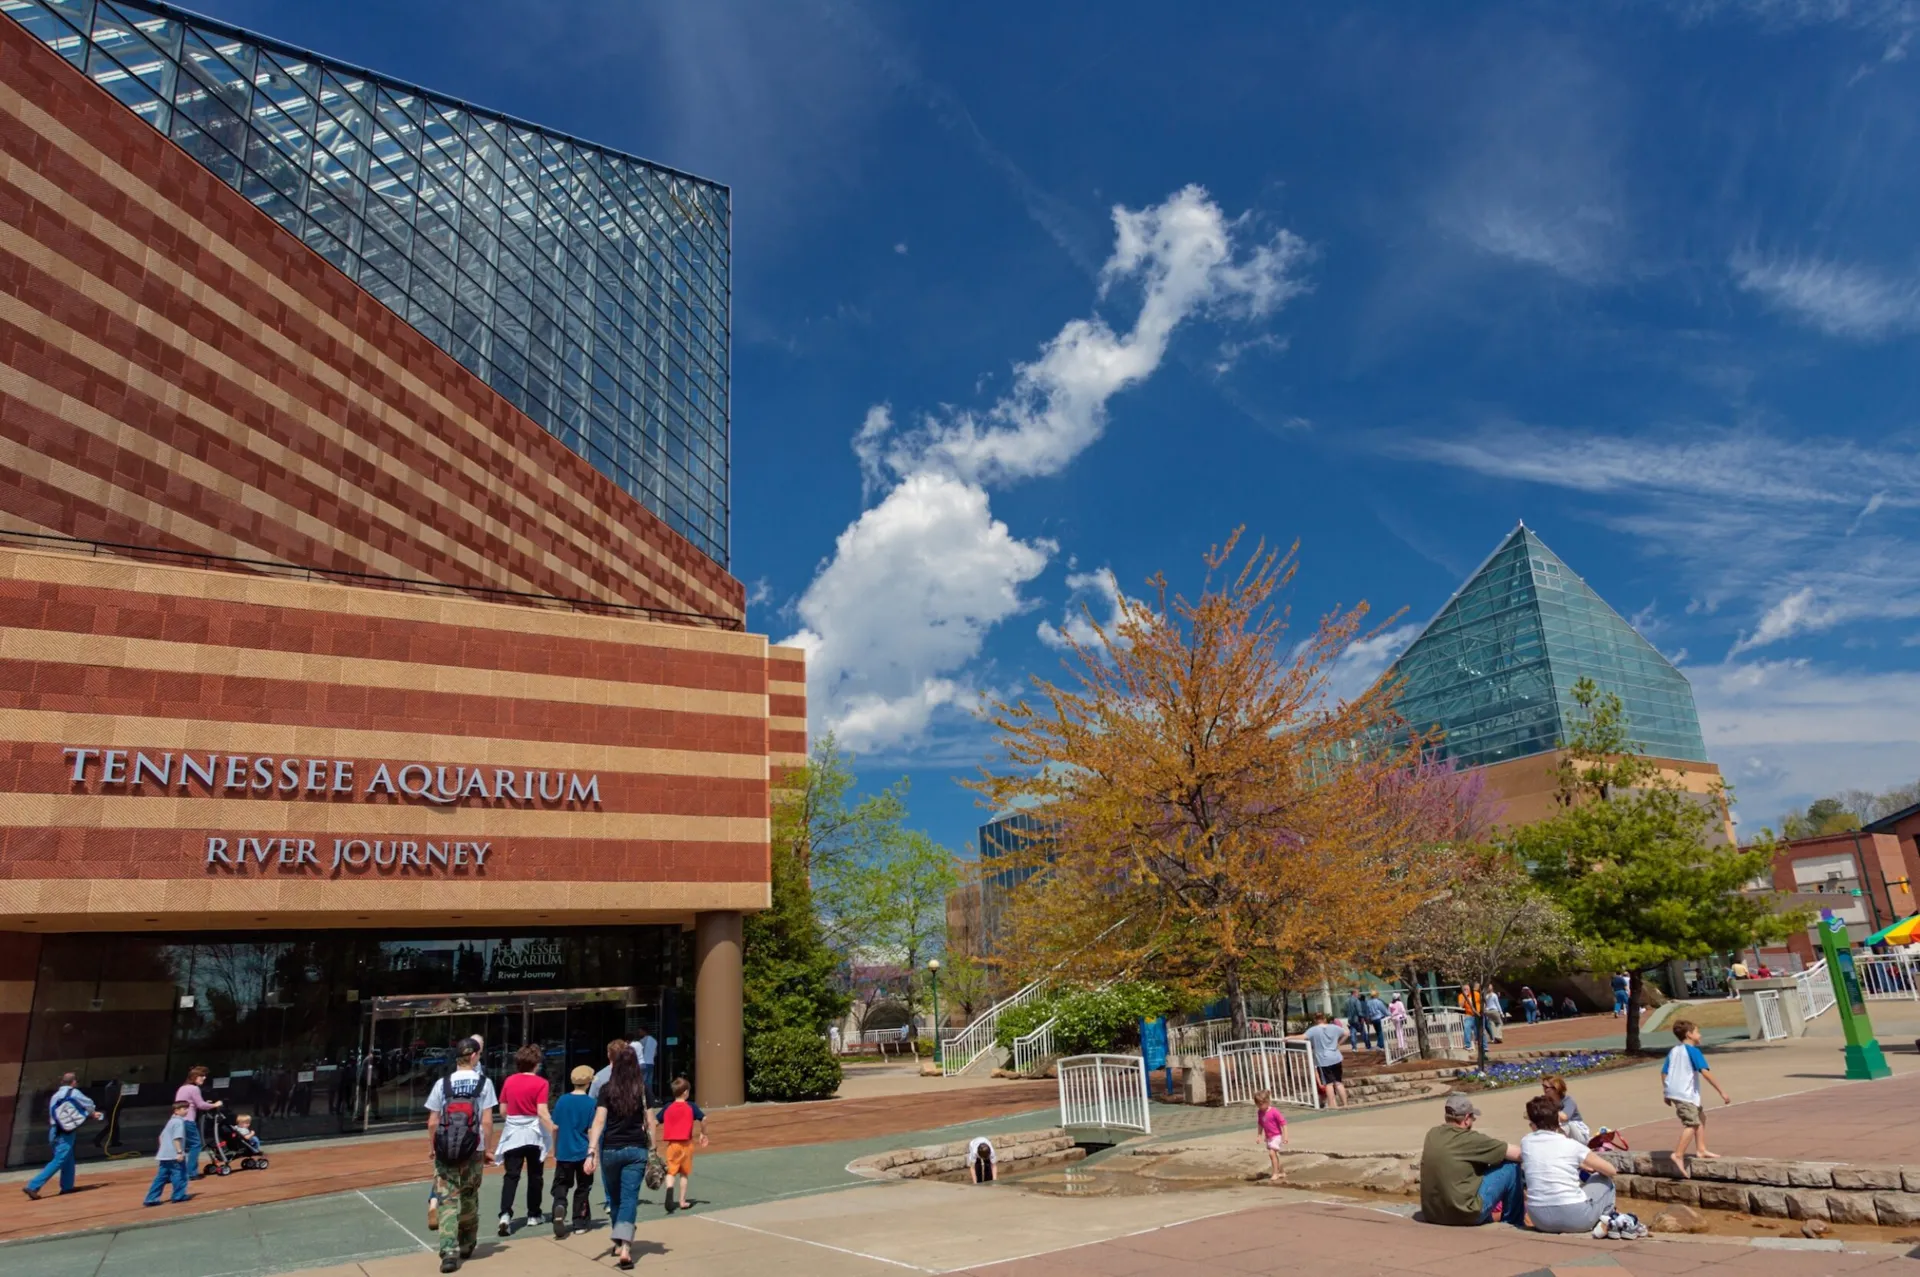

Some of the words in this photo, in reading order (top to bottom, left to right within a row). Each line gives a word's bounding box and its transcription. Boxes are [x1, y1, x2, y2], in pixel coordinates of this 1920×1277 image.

[63, 747, 353, 791] TENNESSEE
[365, 763, 602, 804] AQUARIUM
[206, 837, 321, 863] RIVER
[331, 838, 492, 870] JOURNEY
[494, 954, 563, 968] AQUARIUM
[498, 971, 520, 979] River
[522, 971, 556, 979] Journey
